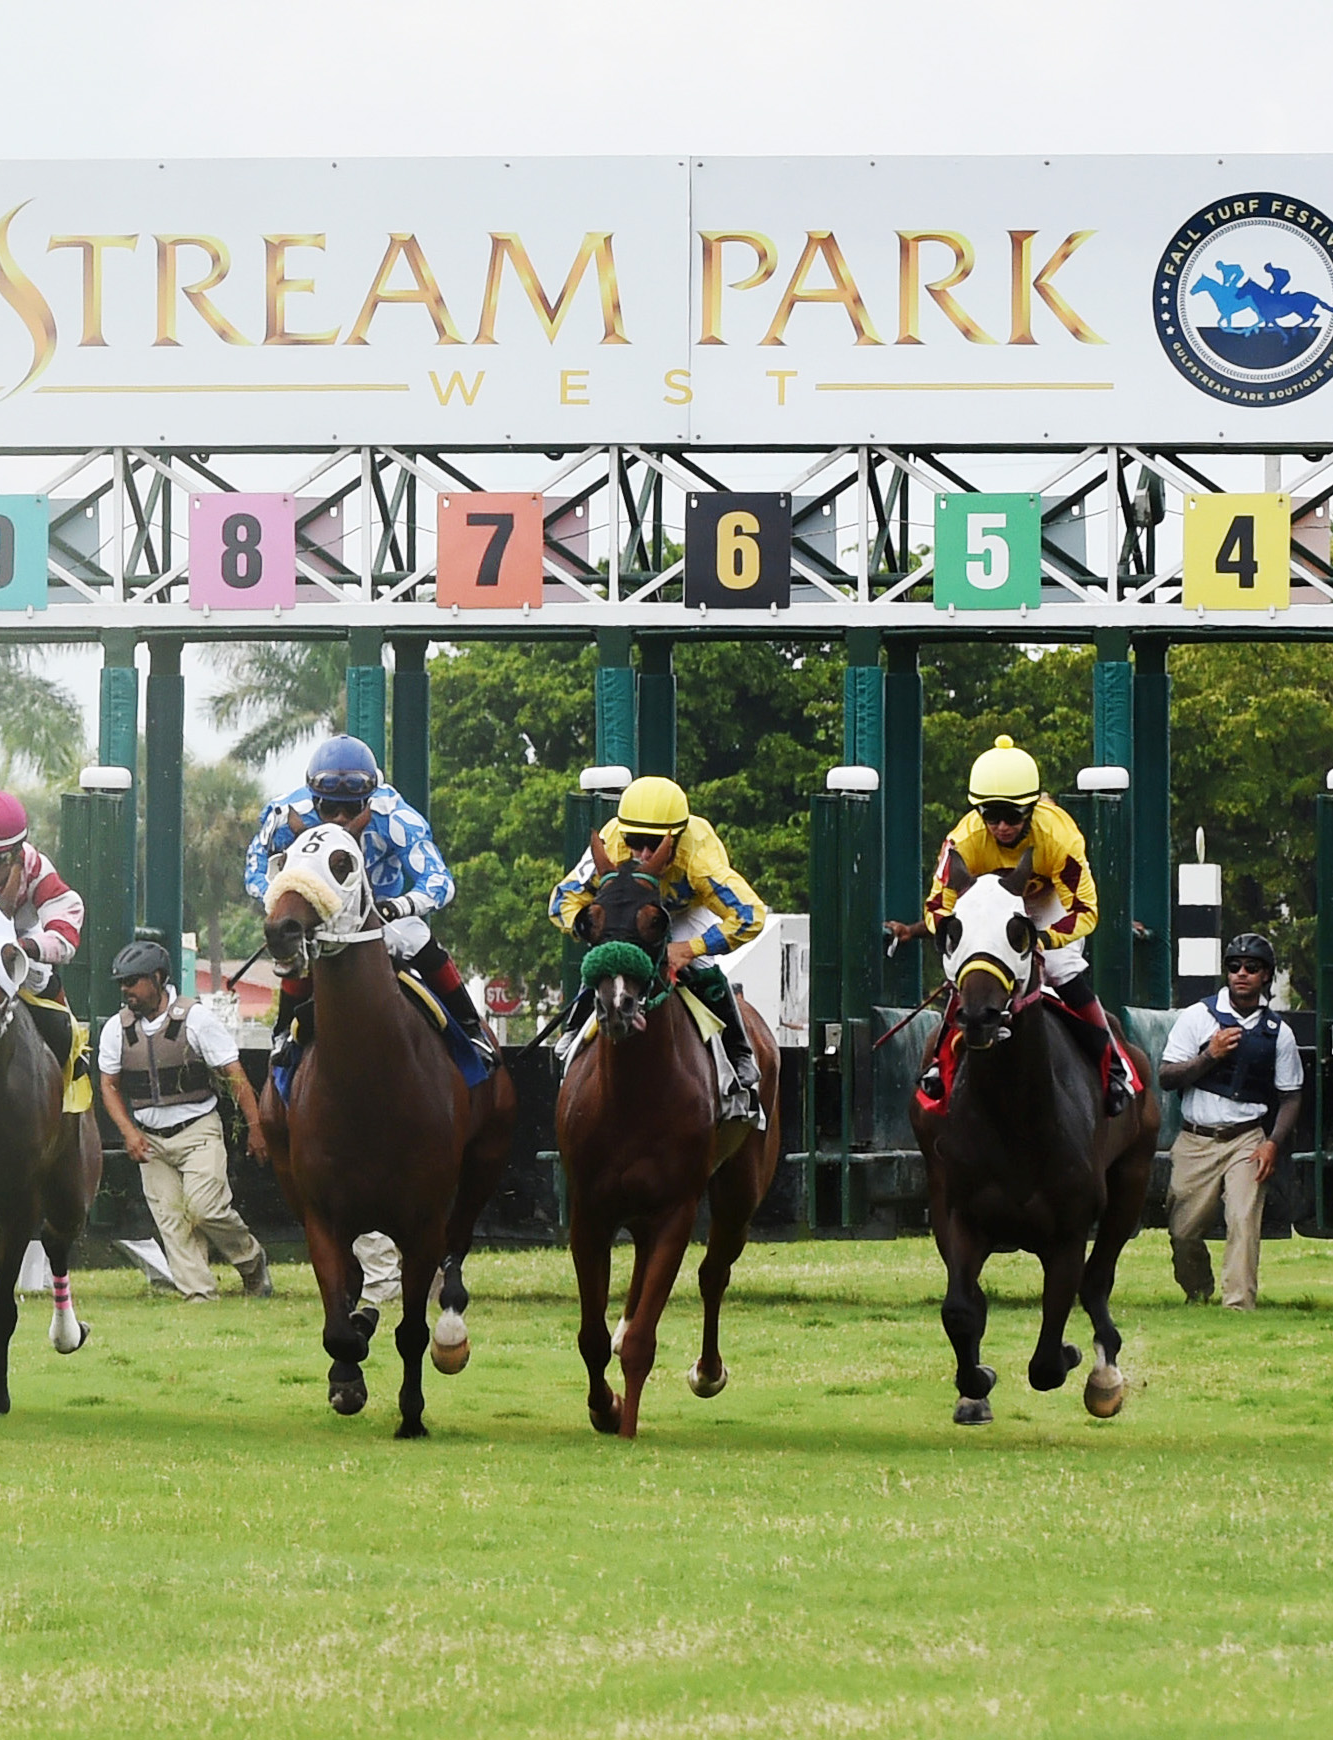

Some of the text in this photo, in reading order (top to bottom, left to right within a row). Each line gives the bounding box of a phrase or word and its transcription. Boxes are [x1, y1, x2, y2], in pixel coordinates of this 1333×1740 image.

[1164, 230, 1202, 276] FALL
[1203, 199, 1260, 227] TURF
[696, 229, 1110, 346] PARK
[428, 368, 799, 406] WEST
[1172, 341, 1325, 402] GULFSTREAM PARK BOUTIQUE
[220, 513, 264, 590] 8
[465, 512, 515, 587] 7
[714, 510, 762, 591] 6
[965, 512, 1011, 591] 5
[1214, 515, 1259, 589] 4
